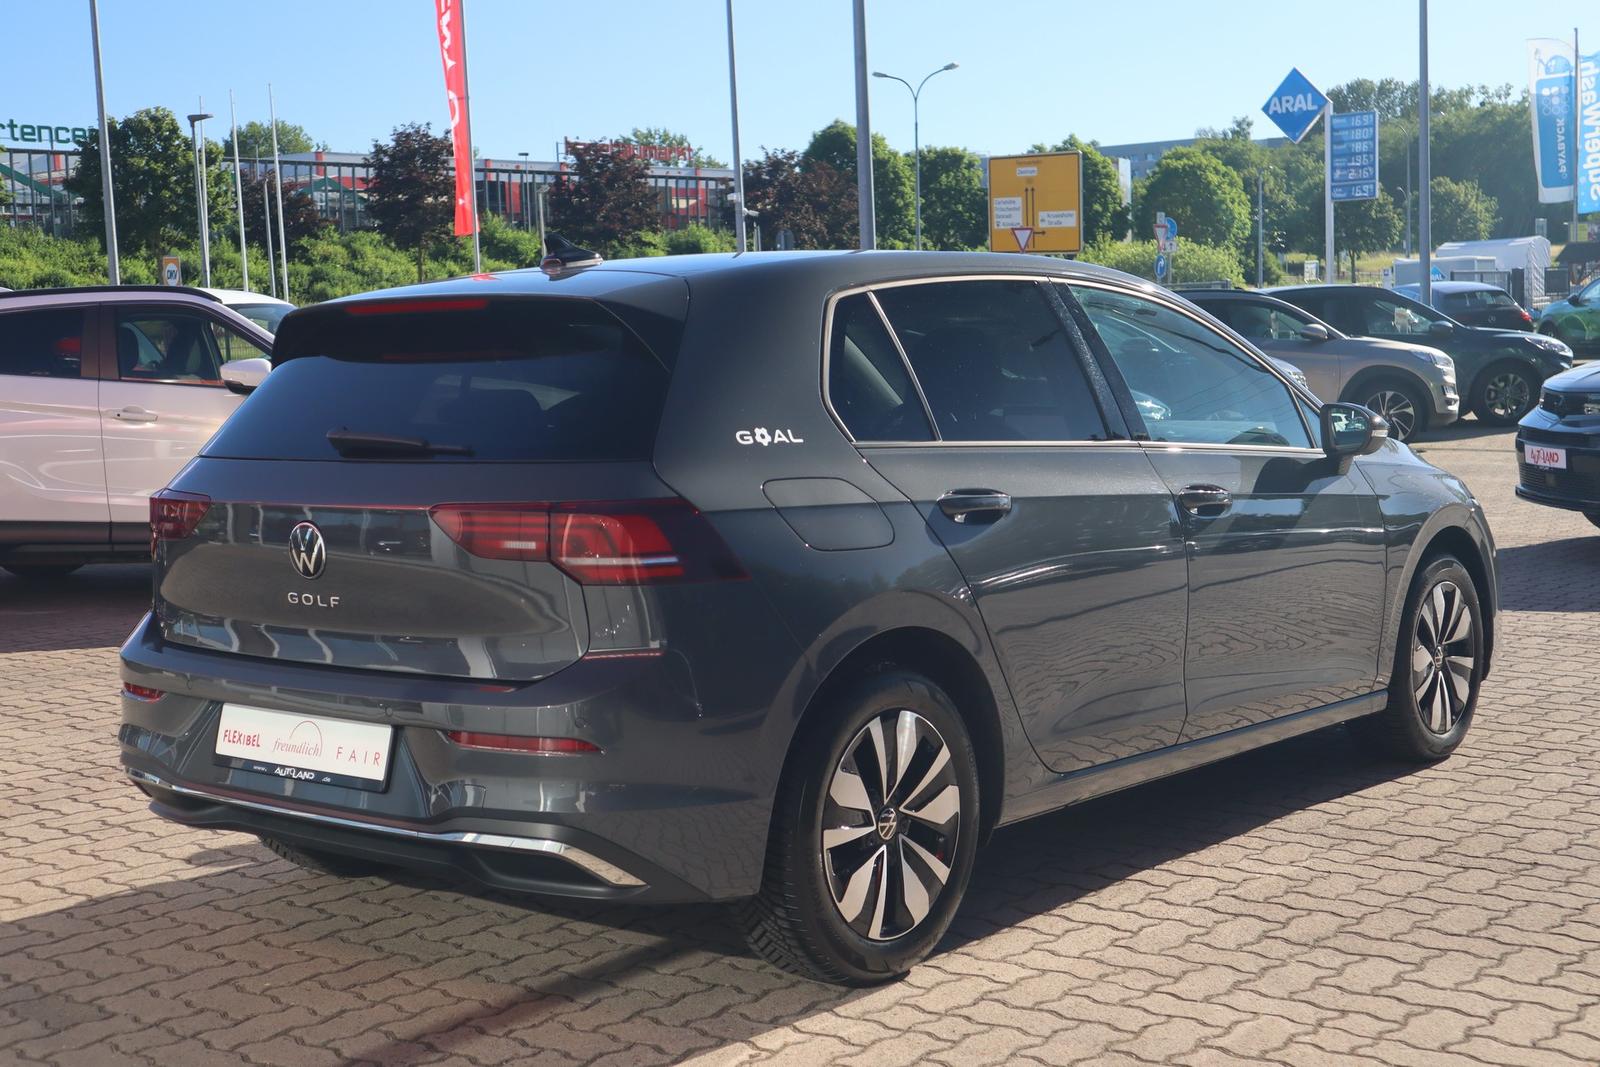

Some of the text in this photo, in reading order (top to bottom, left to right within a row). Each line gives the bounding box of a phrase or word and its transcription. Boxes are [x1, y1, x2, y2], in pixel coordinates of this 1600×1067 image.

[1269, 93, 1318, 115] ARAL
[735, 427, 804, 447] GOAL
[287, 591, 340, 608] GOLF
[223, 729, 382, 767] FLEXIBEL freundlich FAIR
